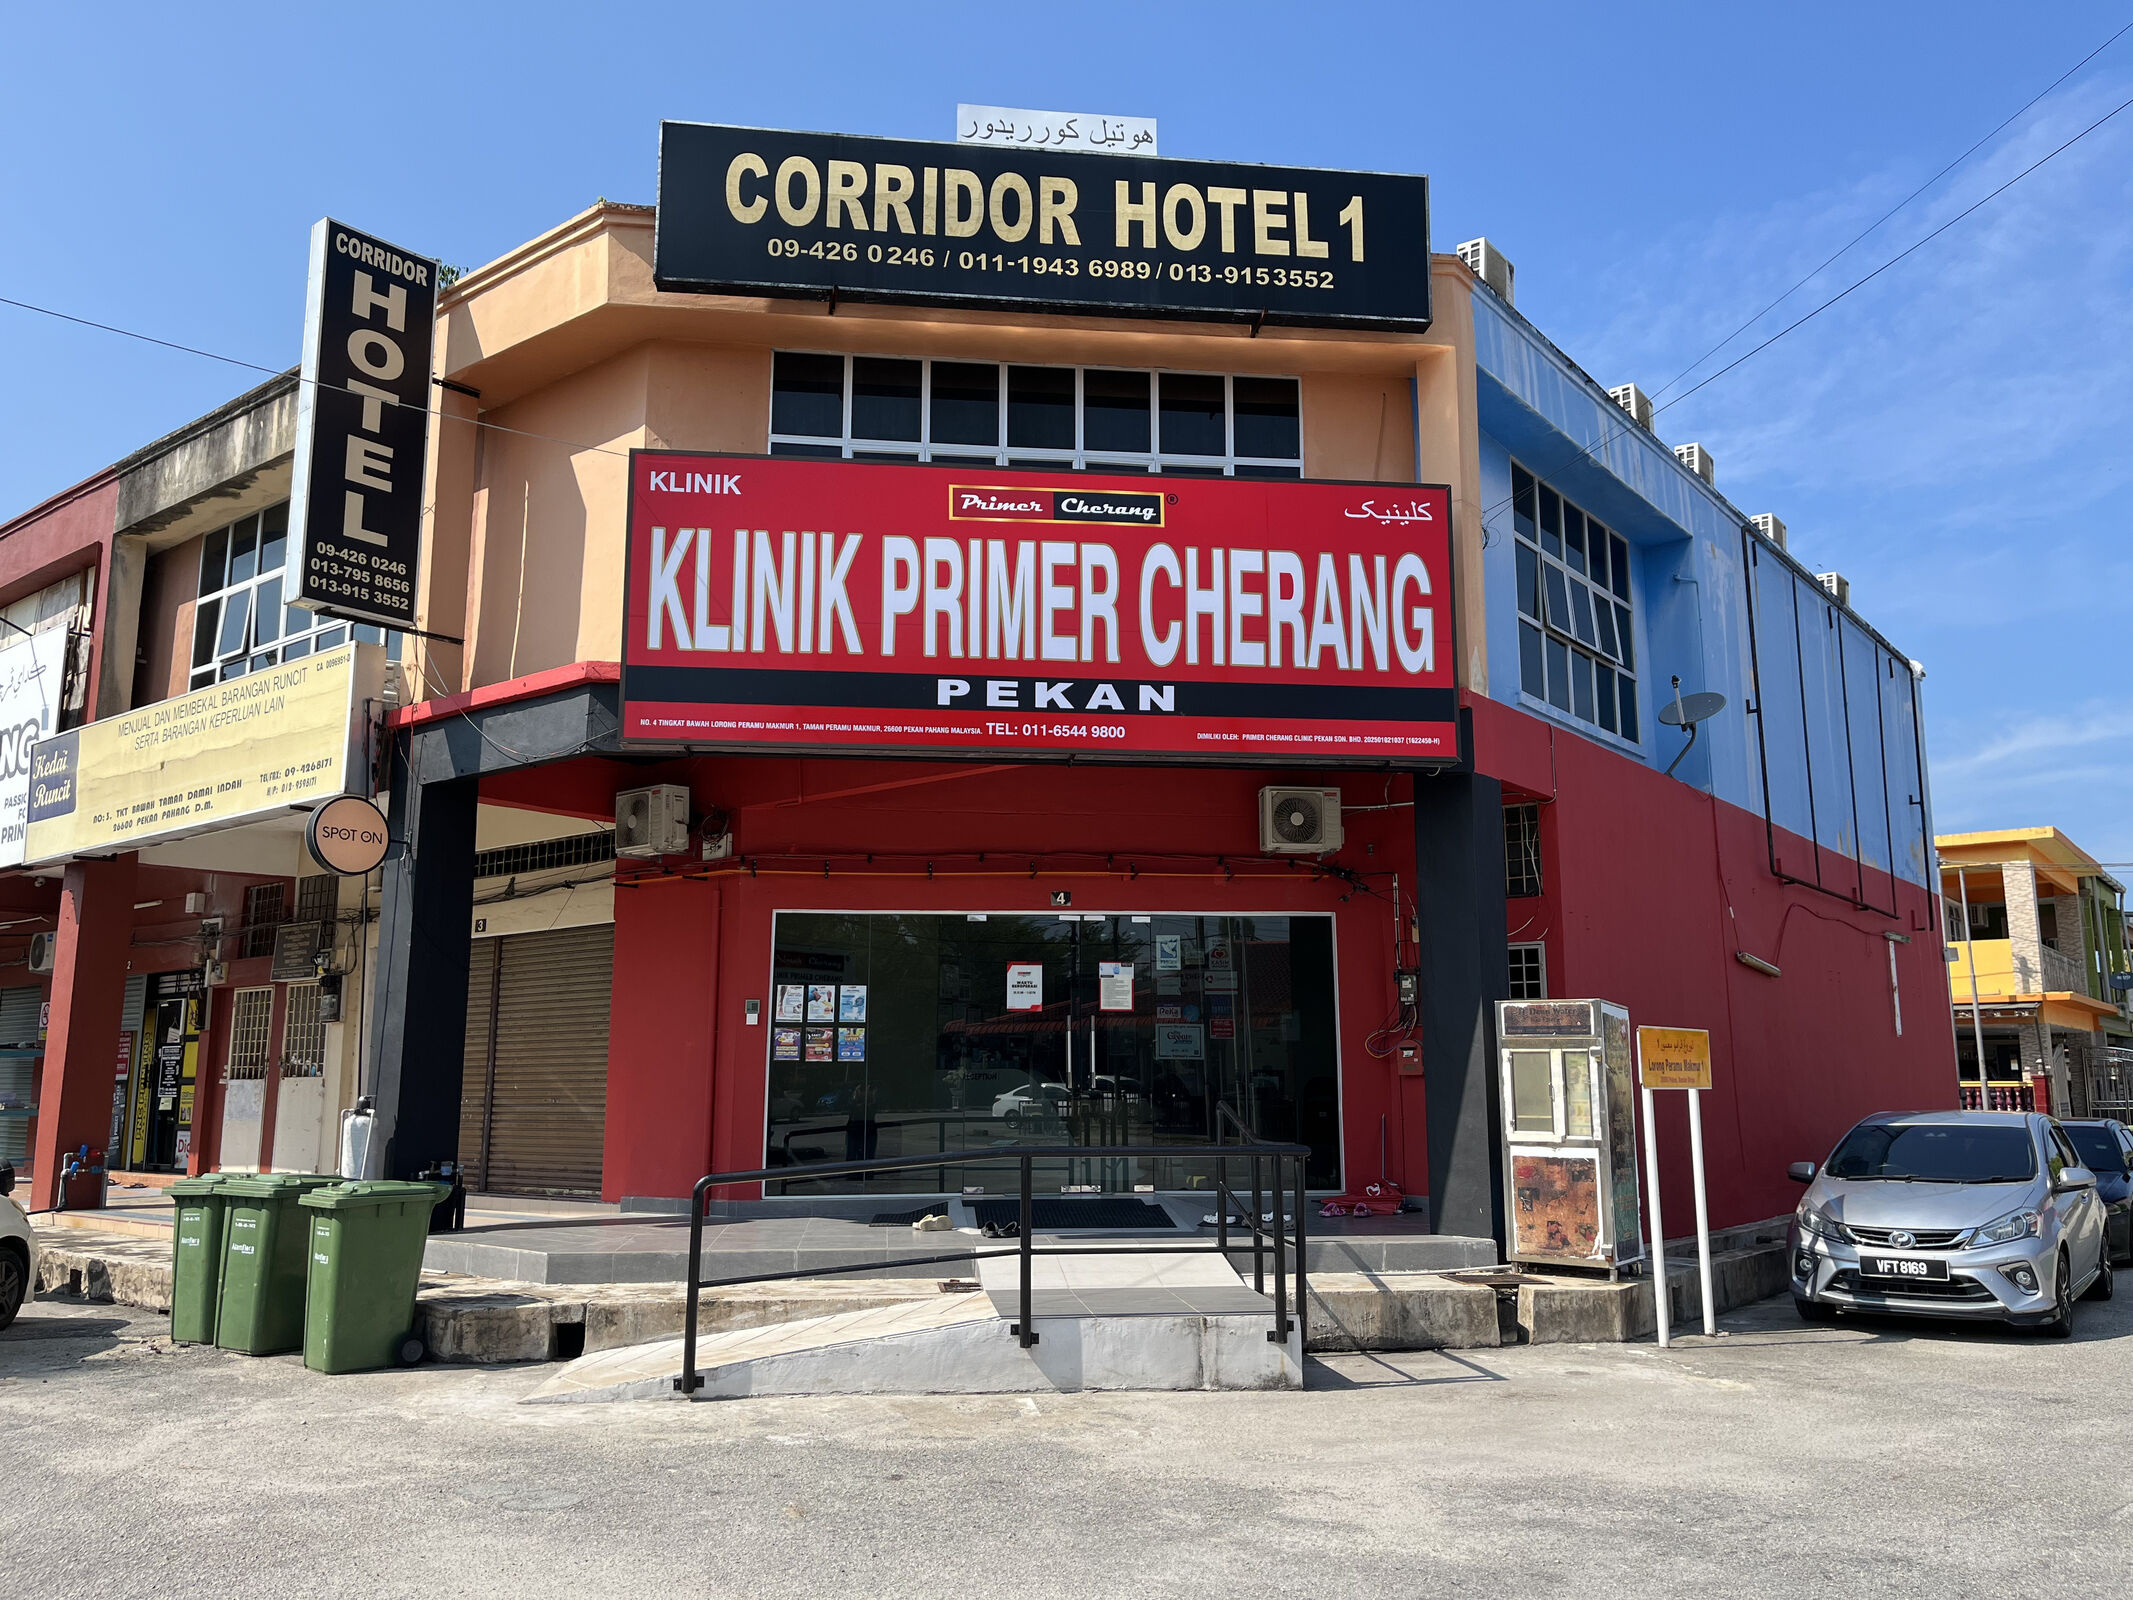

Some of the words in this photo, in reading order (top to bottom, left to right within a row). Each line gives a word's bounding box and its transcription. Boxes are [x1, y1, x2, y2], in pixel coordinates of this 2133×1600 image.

[724, 152, 1081, 246] CORRIDOR
[1115, 179, 1329, 261] HOTEL
[1338, 195, 1365, 263] 1
[335, 232, 428, 287] CORRIDOR
[767, 237, 858, 263] 09-426
[867, 244, 934, 268] 0246
[959, 250, 1080, 277] 011-1943
[1169, 262, 1335, 290] 013-9153552
[342, 270, 408, 547] HOTEL
[648, 470, 742, 496] KLINIK
[960, 494, 1043, 512] Primer
[1061, 497, 1156, 520] Cherang
[316, 541, 367, 566] 09-426
[371, 556, 407, 576] 0246
[310, 557, 371, 585] 013-795
[374, 573, 410, 594] 8656
[309, 574, 370, 602] 013-915
[373, 590, 409, 610] 3552
[646, 526, 865, 655] KLINIK
[882, 536, 1121, 664] PRIMER
[1139, 543, 1436, 673] CHERANG
[118, 715, 151, 737] MENJUAL
[154, 709, 171, 727] DAN
[173, 695, 218, 719] MEMBEKAL
[222, 677, 271, 707] BARANGAN
[273, 667, 308, 692] RUNCIT
[937, 679, 1176, 713] PEKAN
[135, 731, 159, 750] SERTA
[162, 717, 207, 743] BARANGAN
[209, 702, 261, 730] KEPERLUAN
[264, 695, 286, 714] LAIN
[658, 719, 685, 727] TINGKAT
[686, 720, 710, 728] BAWAH
[738, 721, 765, 729] PERAMU
[766, 722, 794, 730] MAKMUR
[803, 723, 824, 731] TAMAN
[825, 724, 852, 732] PERAMU
[925, 726, 949, 734] PAHANG
[986, 722, 1018, 735] TEL:
[1022, 723, 1087, 737] 011-6544
[1091, 725, 1126, 738] 9800
[1265, 734, 1293, 742] CHERANG
[1314, 735, 1333, 743] PEKAN
[32, 750, 68, 780] Kedai
[33, 779, 71, 808] Runcit
[132, 800, 155, 814] BAWAH
[159, 793, 183, 807] TAMAN
[187, 786, 213, 800] DAMAI
[217, 780, 242, 793] INDAH
[137, 813, 158, 826] PEKAN
[162, 806, 190, 820] PAHANG
[322, 826, 357, 844] SPOT
[361, 829, 383, 846] ON
[1057, 892, 1065, 904] 4
[477, 919, 484, 932] 3
[1648, 1058, 1665, 1074] Lorong
[1876, 1260, 1899, 1273] VFT
[1900, 1262, 1927, 1275] 8169
